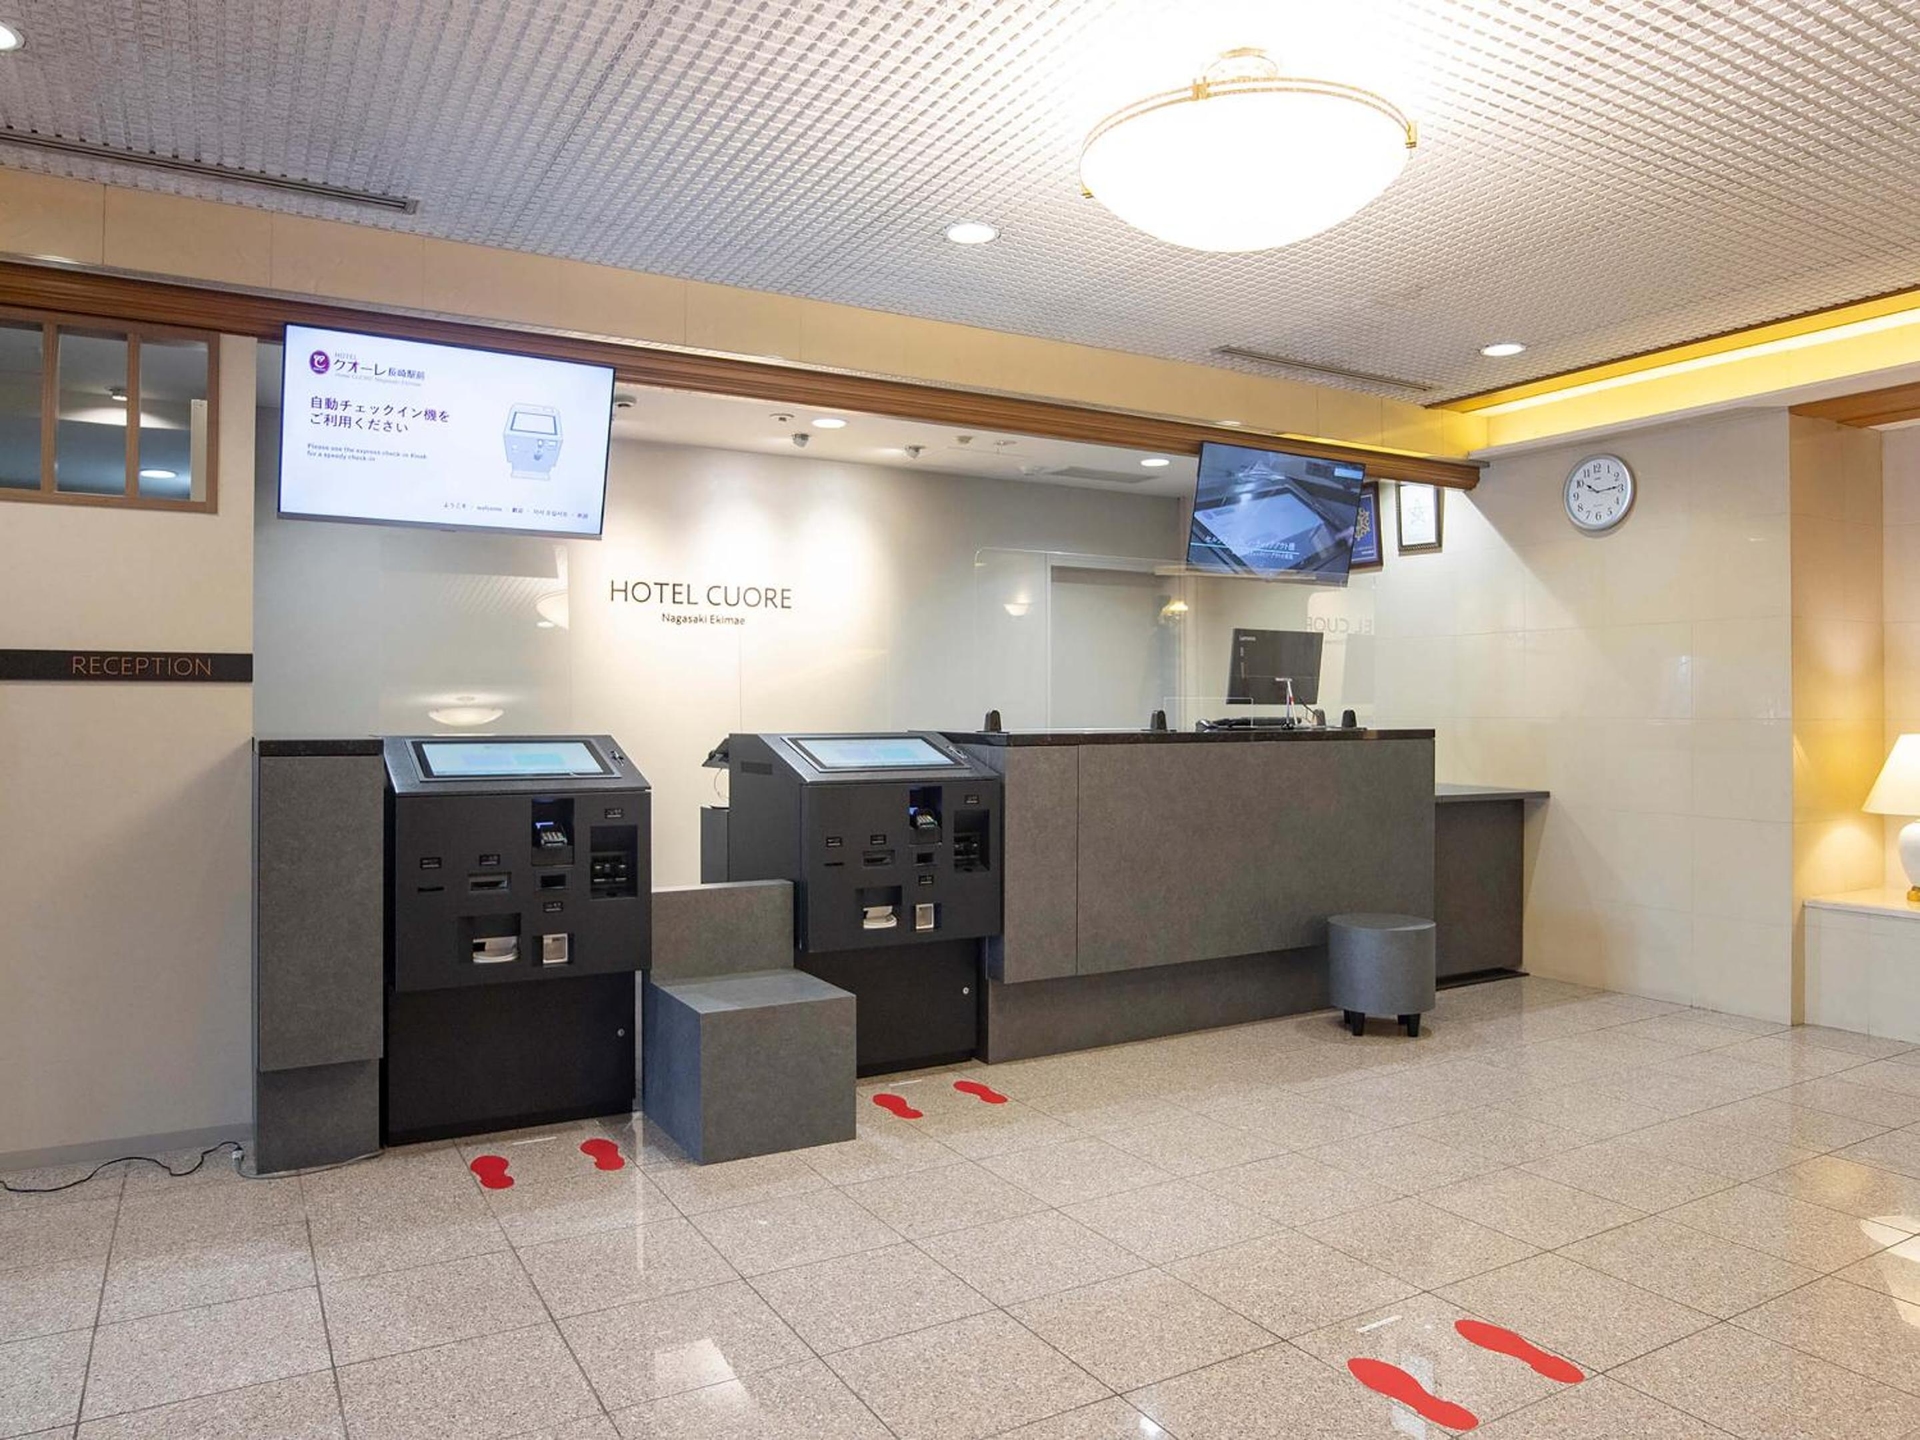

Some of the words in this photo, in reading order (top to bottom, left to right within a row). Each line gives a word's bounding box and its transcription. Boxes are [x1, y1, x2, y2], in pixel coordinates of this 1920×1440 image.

[311, 396, 449, 422] 自動チェックイン機を
[310, 412, 408, 432] ご利用ください
[1583, 469, 1590, 478] 11
[1593, 463, 1602, 474] 12
[1606, 464, 1610, 474] 1
[1613, 472, 1620, 481] 2
[1576, 480, 1585, 488] 10
[1618, 483, 1624, 493] 3
[1573, 492, 1579, 501] 9
[1577, 503, 1583, 512] 8
[1606, 507, 1613, 516] 5
[1586, 510, 1592, 520] 7
[1595, 512, 1602, 520] 6
[610, 579, 699, 605] HOTEL
[707, 585, 793, 609] CUORE
[661, 613, 708, 626] Nagasaki
[709, 614, 746, 626] Ekimae
[72, 655, 212, 676] RECEPTION
